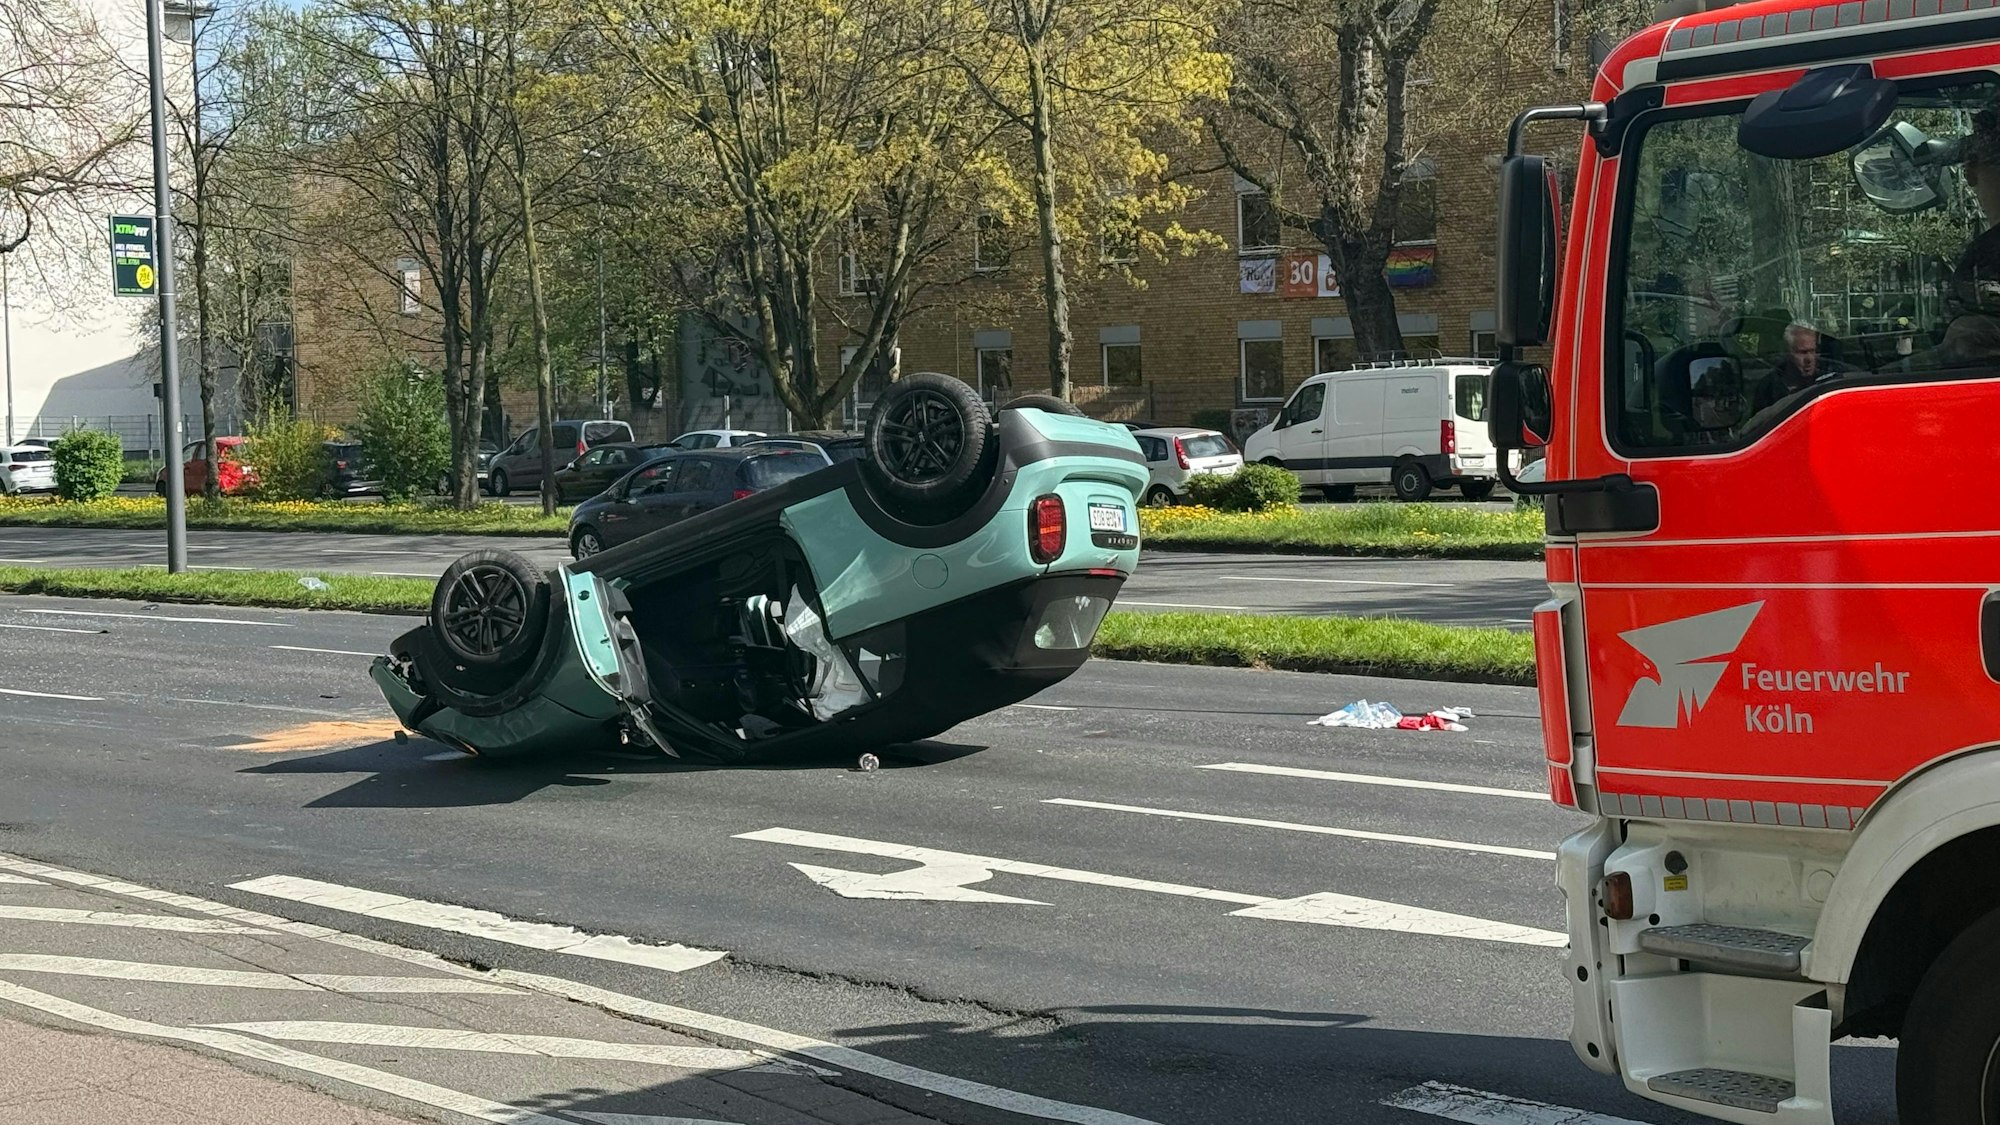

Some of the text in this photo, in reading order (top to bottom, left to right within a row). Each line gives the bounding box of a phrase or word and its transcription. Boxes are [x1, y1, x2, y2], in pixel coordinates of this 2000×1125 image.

[115, 224, 149, 236] XTRAFIT
[1741, 662, 1910, 693] Feuerwehr
[1745, 703, 1814, 734] Köln
